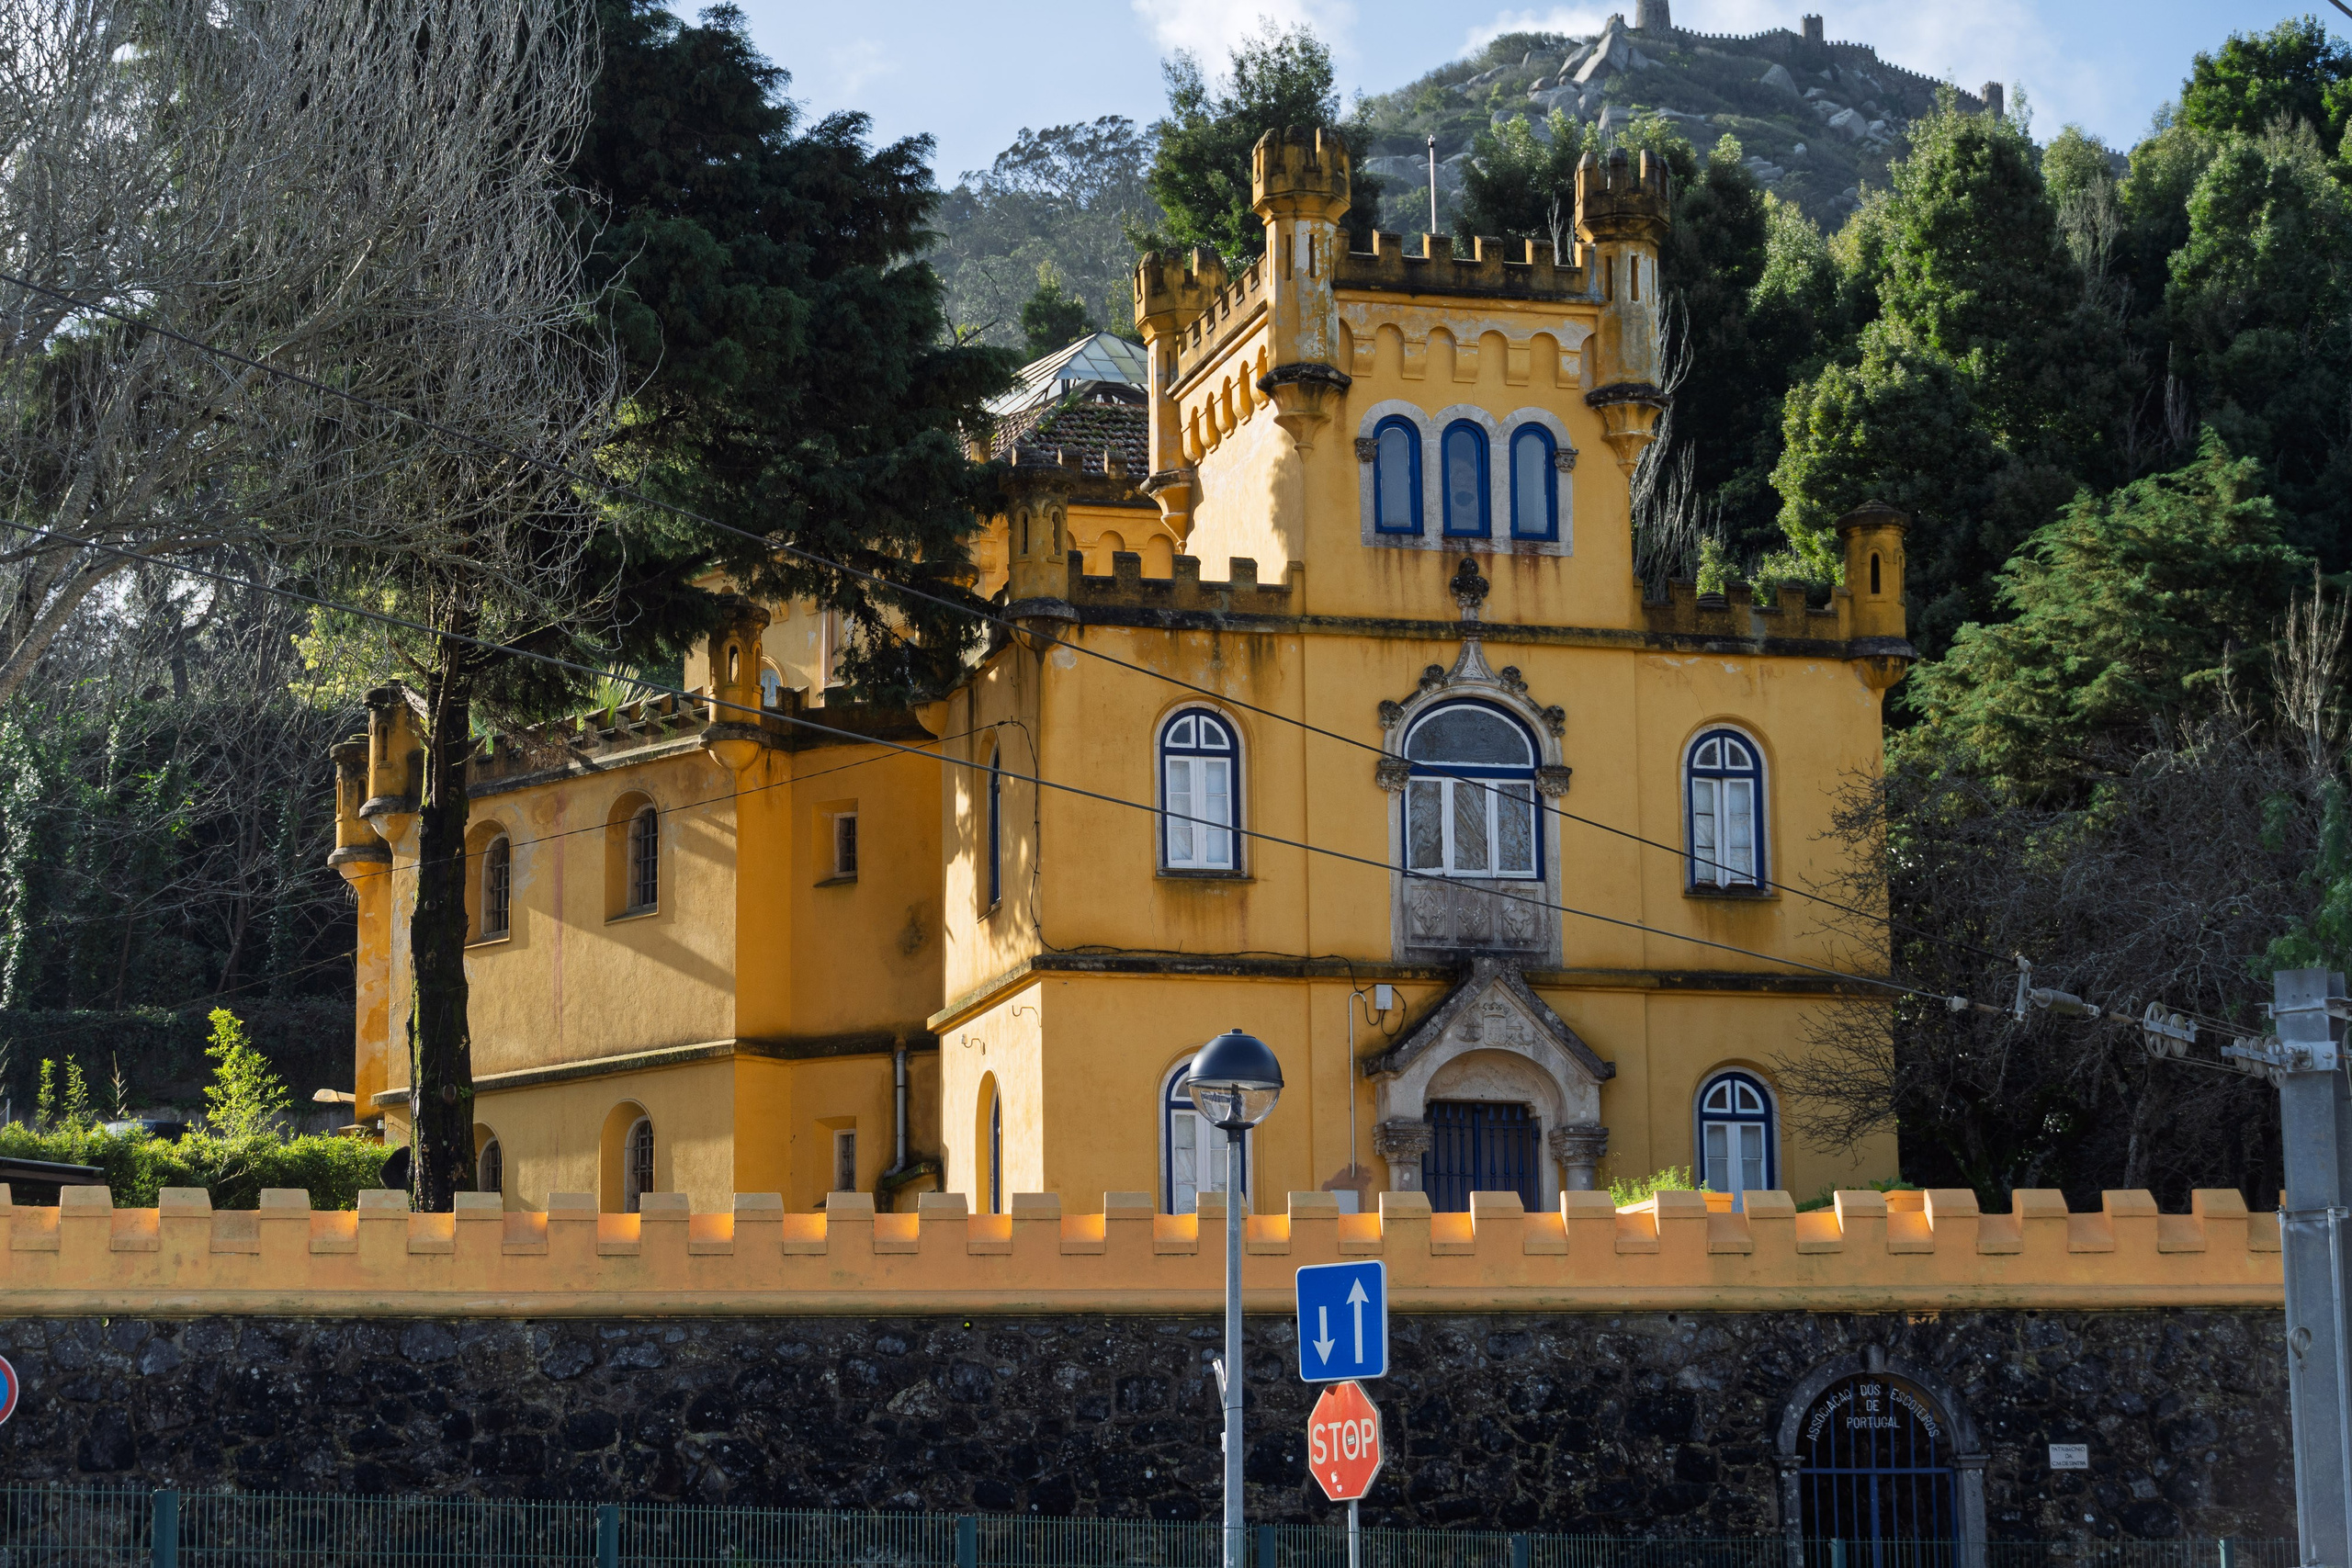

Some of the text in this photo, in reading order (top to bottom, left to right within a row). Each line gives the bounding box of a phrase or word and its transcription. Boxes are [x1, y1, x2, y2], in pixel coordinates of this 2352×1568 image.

[1860, 1384, 1881, 1396] DOS
[1890, 1388, 1939, 1437] ESCOTEIROS
[1866, 1399, 1880, 1411] DE
[1846, 1416, 1901, 1429] PORTUGAL
[1312, 1418, 1375, 1465] STOP
